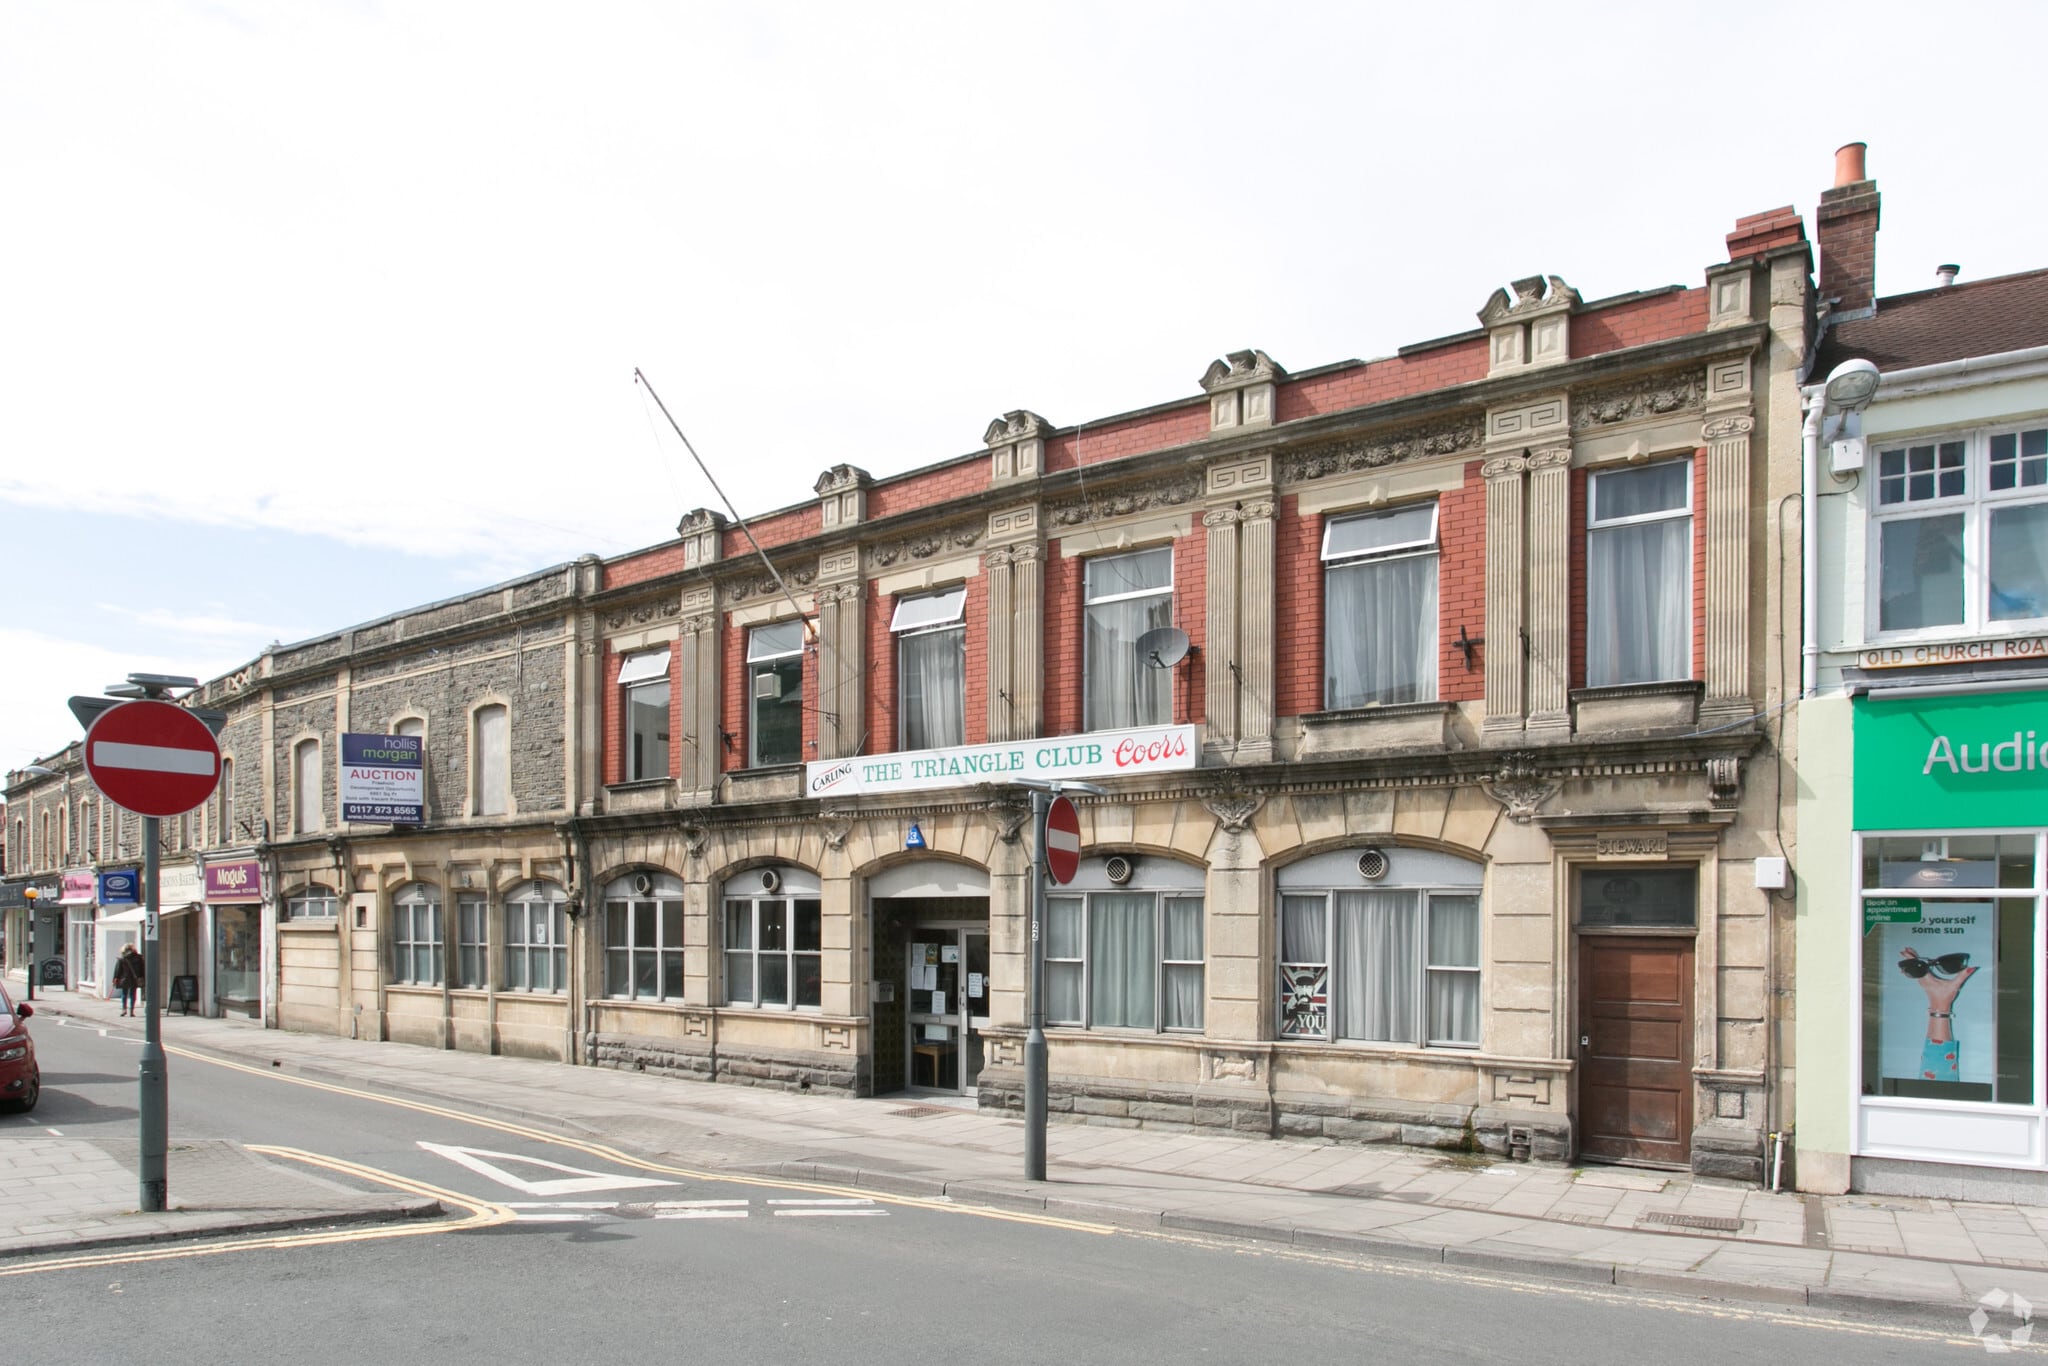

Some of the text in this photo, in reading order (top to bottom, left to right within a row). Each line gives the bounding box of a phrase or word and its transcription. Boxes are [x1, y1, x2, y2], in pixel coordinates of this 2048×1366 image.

[1867, 638, 2048, 665] OLD CHURCH ROA
[384, 737, 418, 750] hollis
[1112, 733, 1187, 767] Coors
[363, 749, 417, 761] morgan
[1922, 730, 2048, 775] Audi
[863, 744, 1103, 783] THE TRIANGLE CLUB
[350, 769, 416, 781] AUCTION
[812, 763, 852, 792] CARLING
[350, 805, 417, 815] 0117 973 6565
[1598, 838, 1667, 855] STEWARD
[216, 865, 248, 889] Moguls
[1866, 906, 1917, 914] appointment
[1929, 916, 1976, 925] yourself
[1911, 927, 1965, 935] some sun
[1297, 1014, 1325, 1030] YOU
